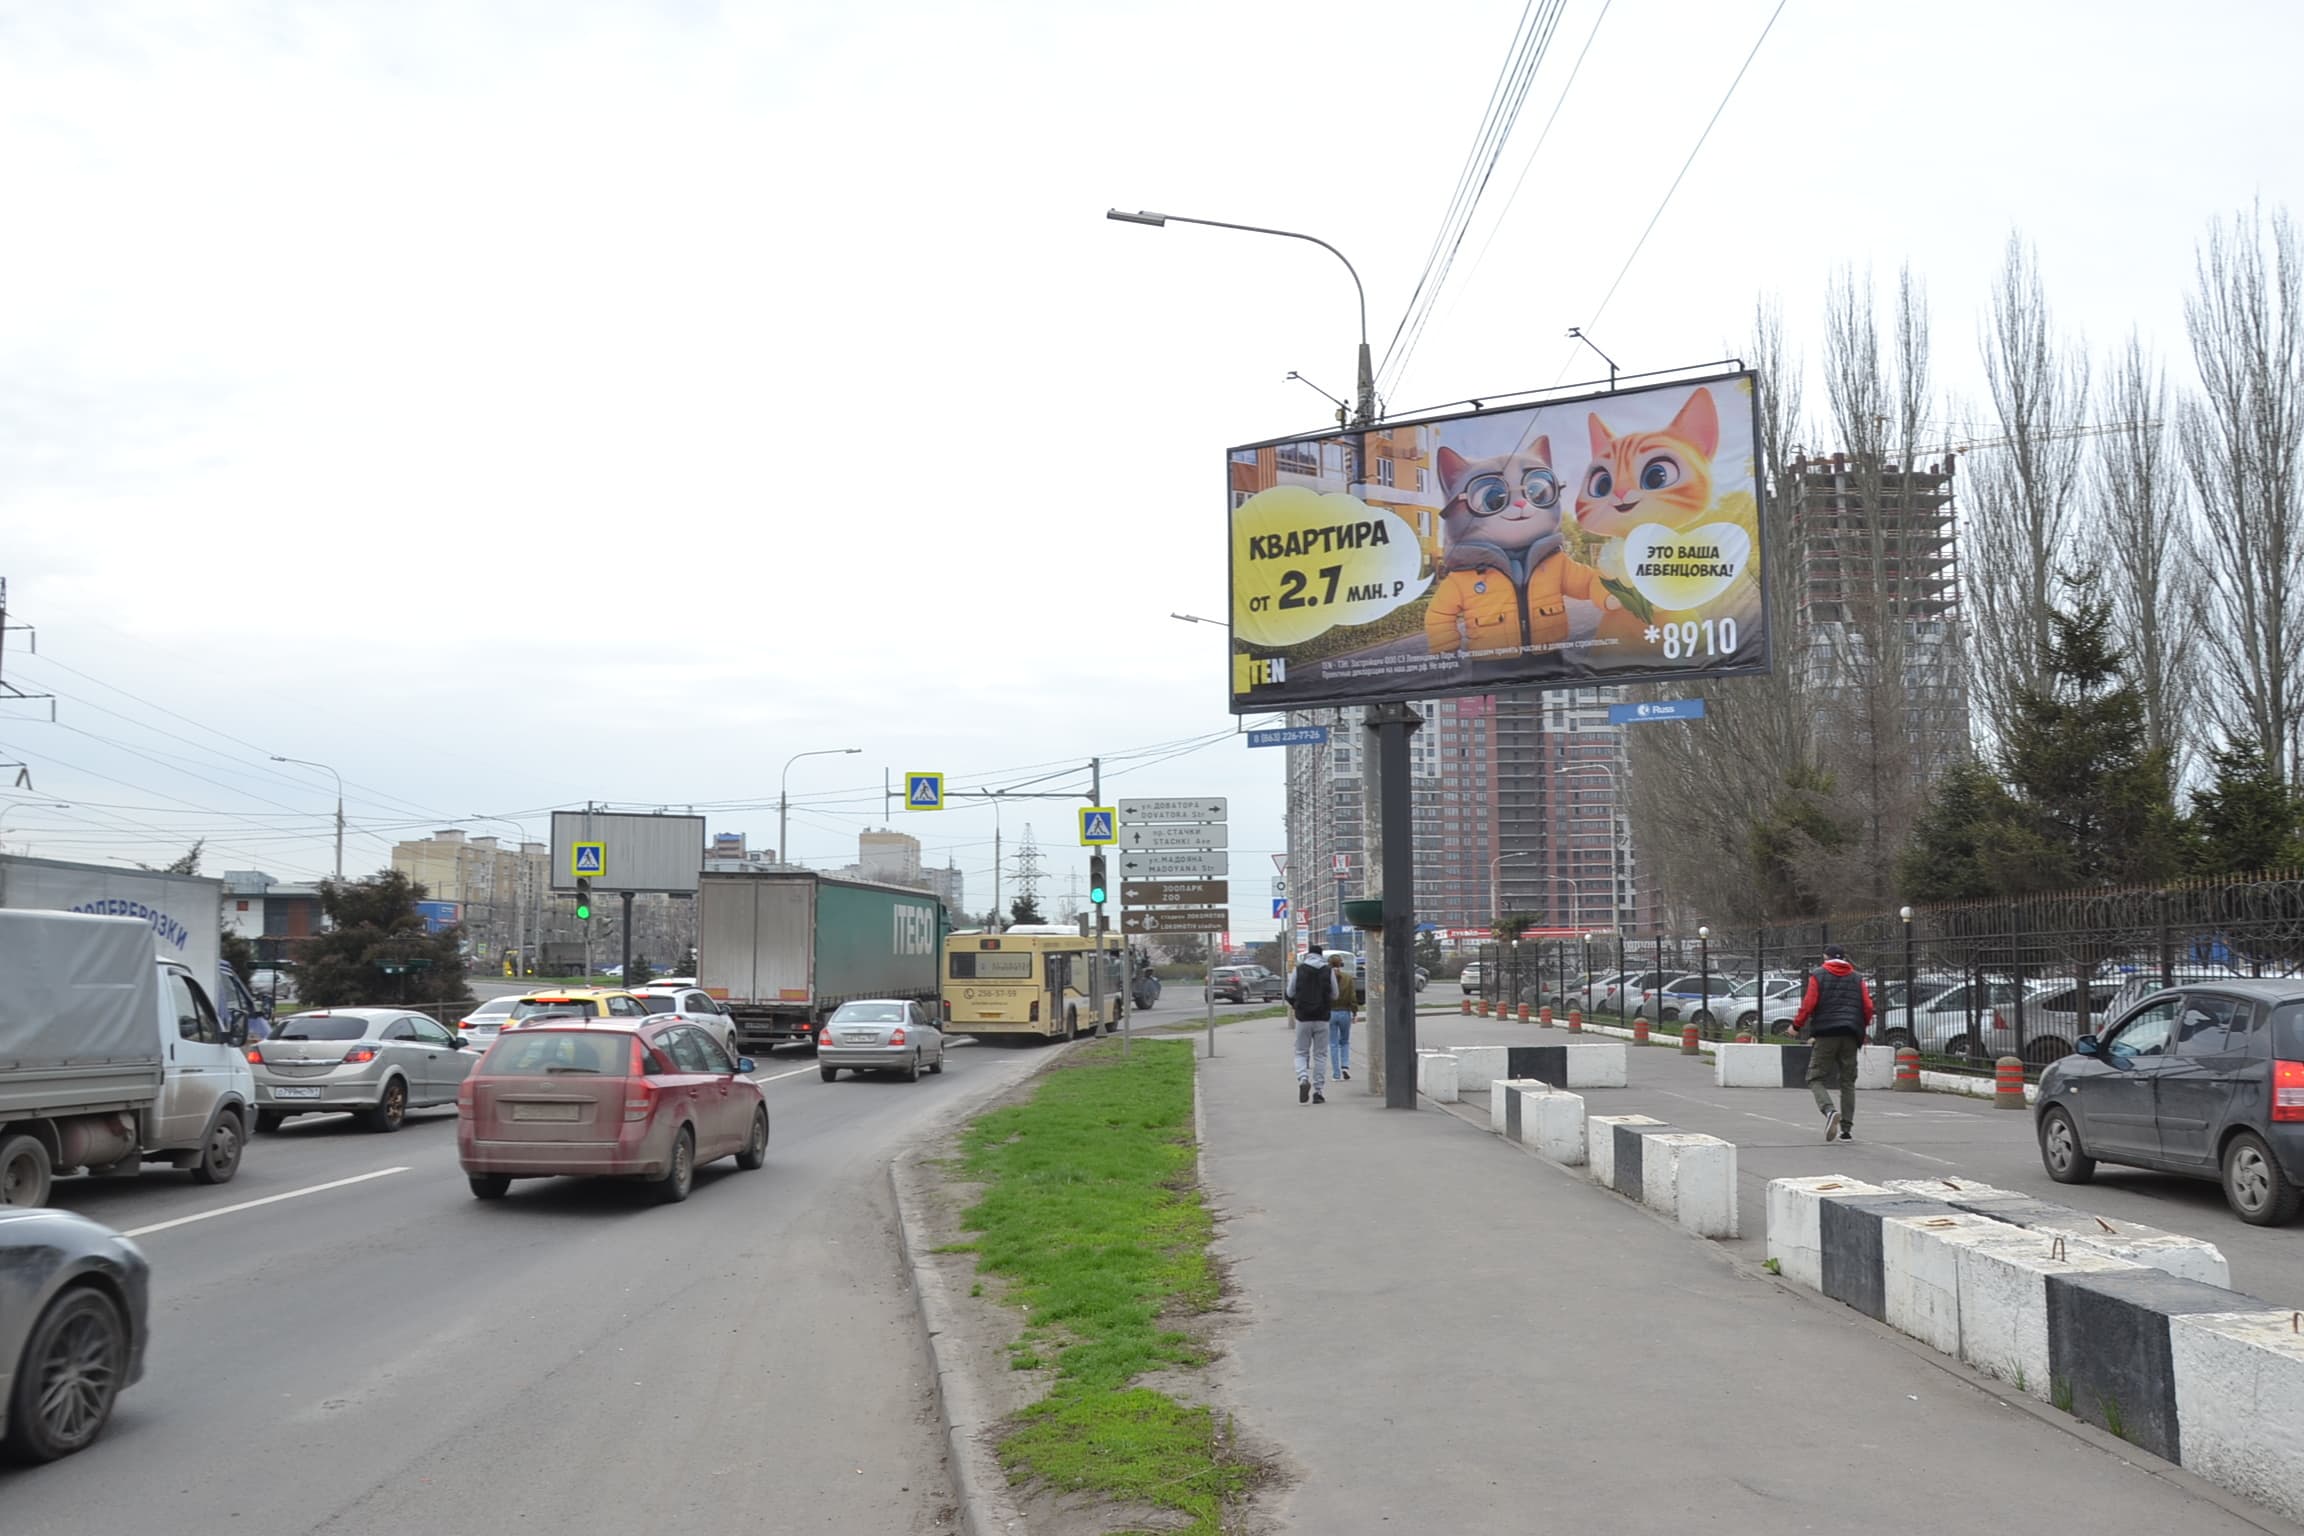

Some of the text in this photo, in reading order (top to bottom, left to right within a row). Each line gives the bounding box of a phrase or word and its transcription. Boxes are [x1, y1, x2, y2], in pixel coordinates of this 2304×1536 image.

[1249, 519, 1390, 561] КВАРТИРА
[1647, 546, 1720, 559] ЭТО ВАША
[1636, 564, 1735, 578] ЛЕВЕНЦОВКА!
[1278, 564, 1344, 611] 2.7
[1652, 705, 1675, 714] Russ
[1141, 810, 1187, 819] DOVATORA
[1148, 865, 1197, 873] MADOYANA
[1162, 884, 1204, 892] ЗООПАРК
[1162, 893, 1181, 902] ZOO
[893, 903, 934, 955] ITECO
